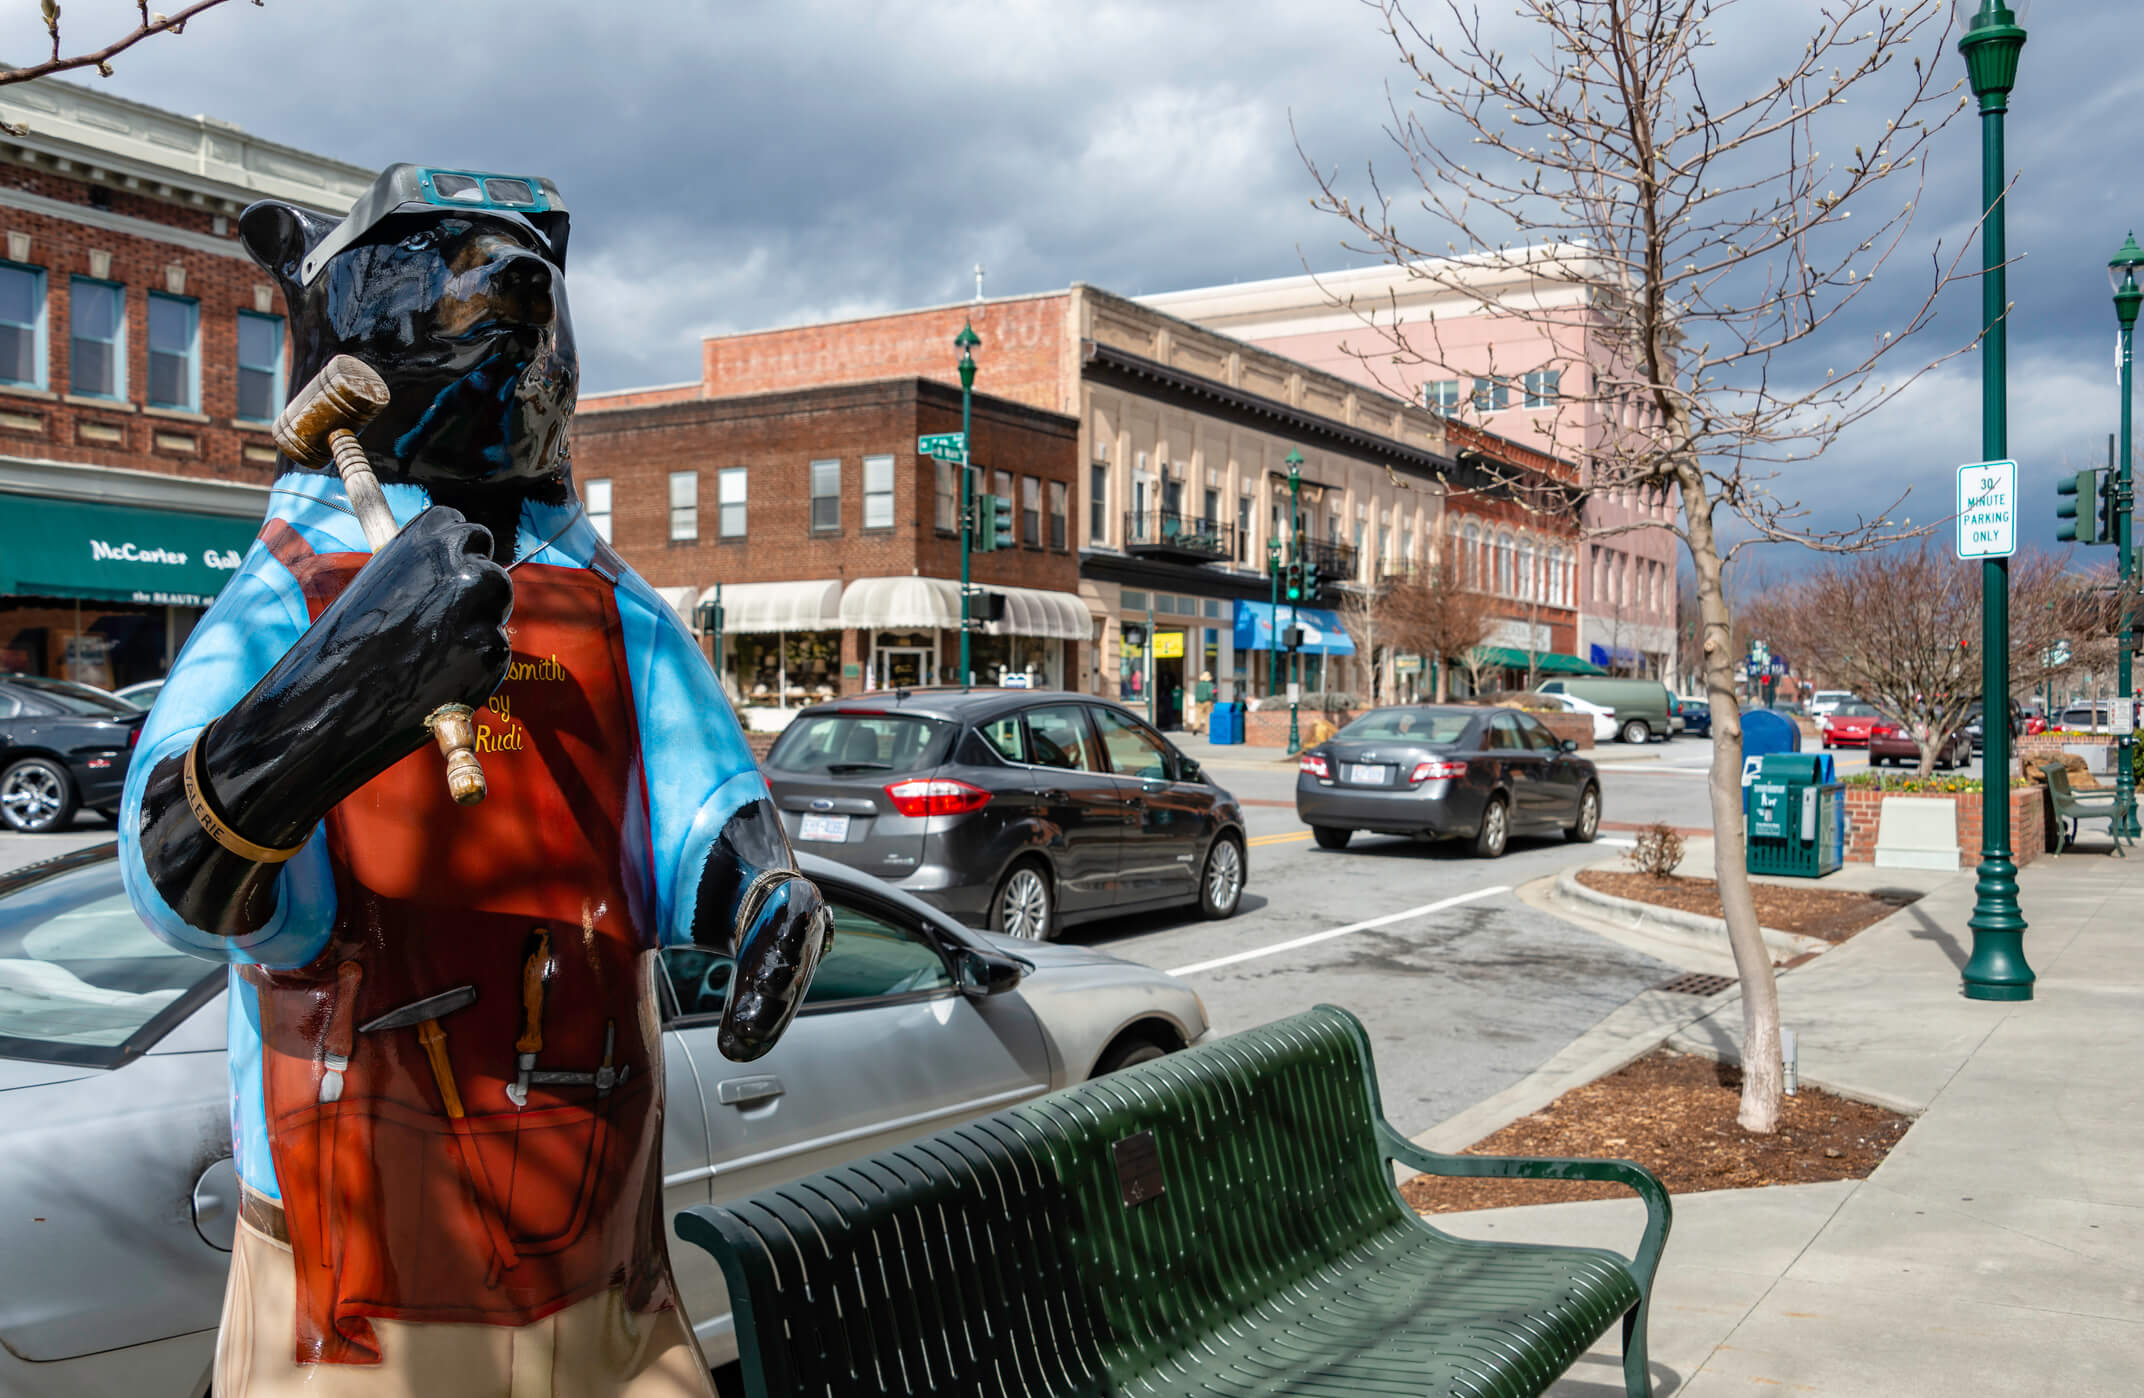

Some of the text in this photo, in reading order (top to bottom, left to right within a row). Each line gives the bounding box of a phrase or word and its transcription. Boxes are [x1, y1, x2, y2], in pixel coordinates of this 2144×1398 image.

[1980, 477, 1993, 490] 30
[1967, 494, 2005, 508] MINUTE
[1963, 511, 2009, 526] PARKING
[1972, 529, 2000, 543] ONLY
[89, 539, 242, 570] McCarter Gall
[131, 590, 151, 602] the
[152, 592, 200, 605] BEAUTY
[504, 653, 566, 682] smith
[475, 723, 524, 753] Rudi
[185, 767, 225, 841] VALERIE
